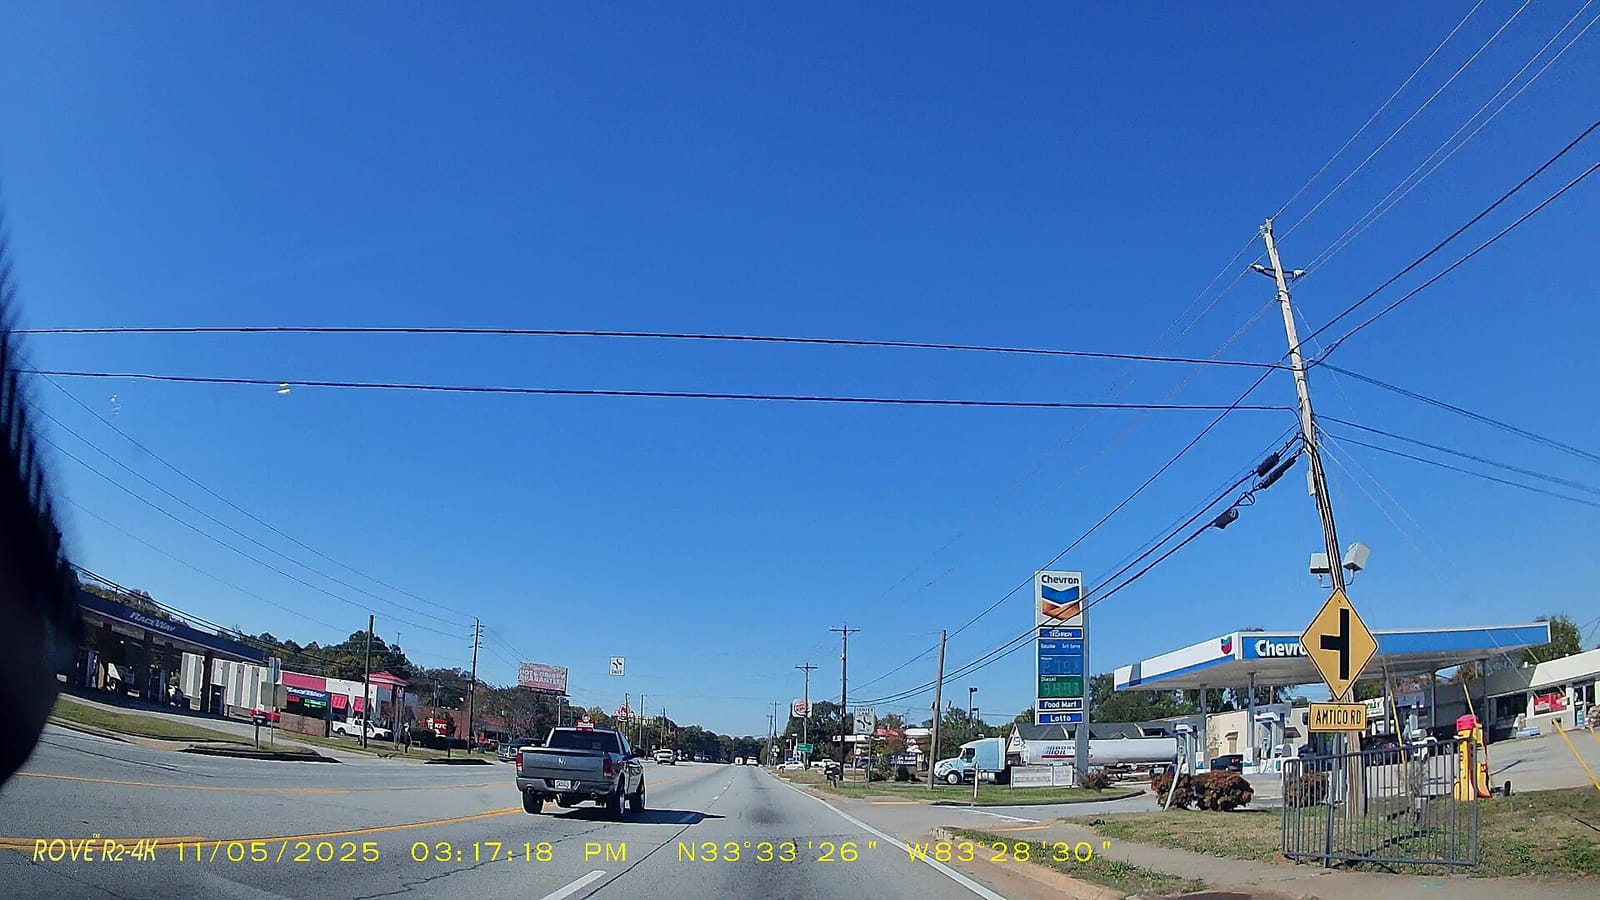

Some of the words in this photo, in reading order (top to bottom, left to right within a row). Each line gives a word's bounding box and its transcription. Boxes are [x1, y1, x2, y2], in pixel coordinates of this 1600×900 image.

[1041, 574, 1079, 584] Chevron
[1255, 639, 1307, 657] Chevro
[1050, 714, 1071, 722] Lotto
[1316, 709, 1348, 725] AMTICO
[1350, 709, 1361, 725] RD
[434, 722, 447, 730] KFC
